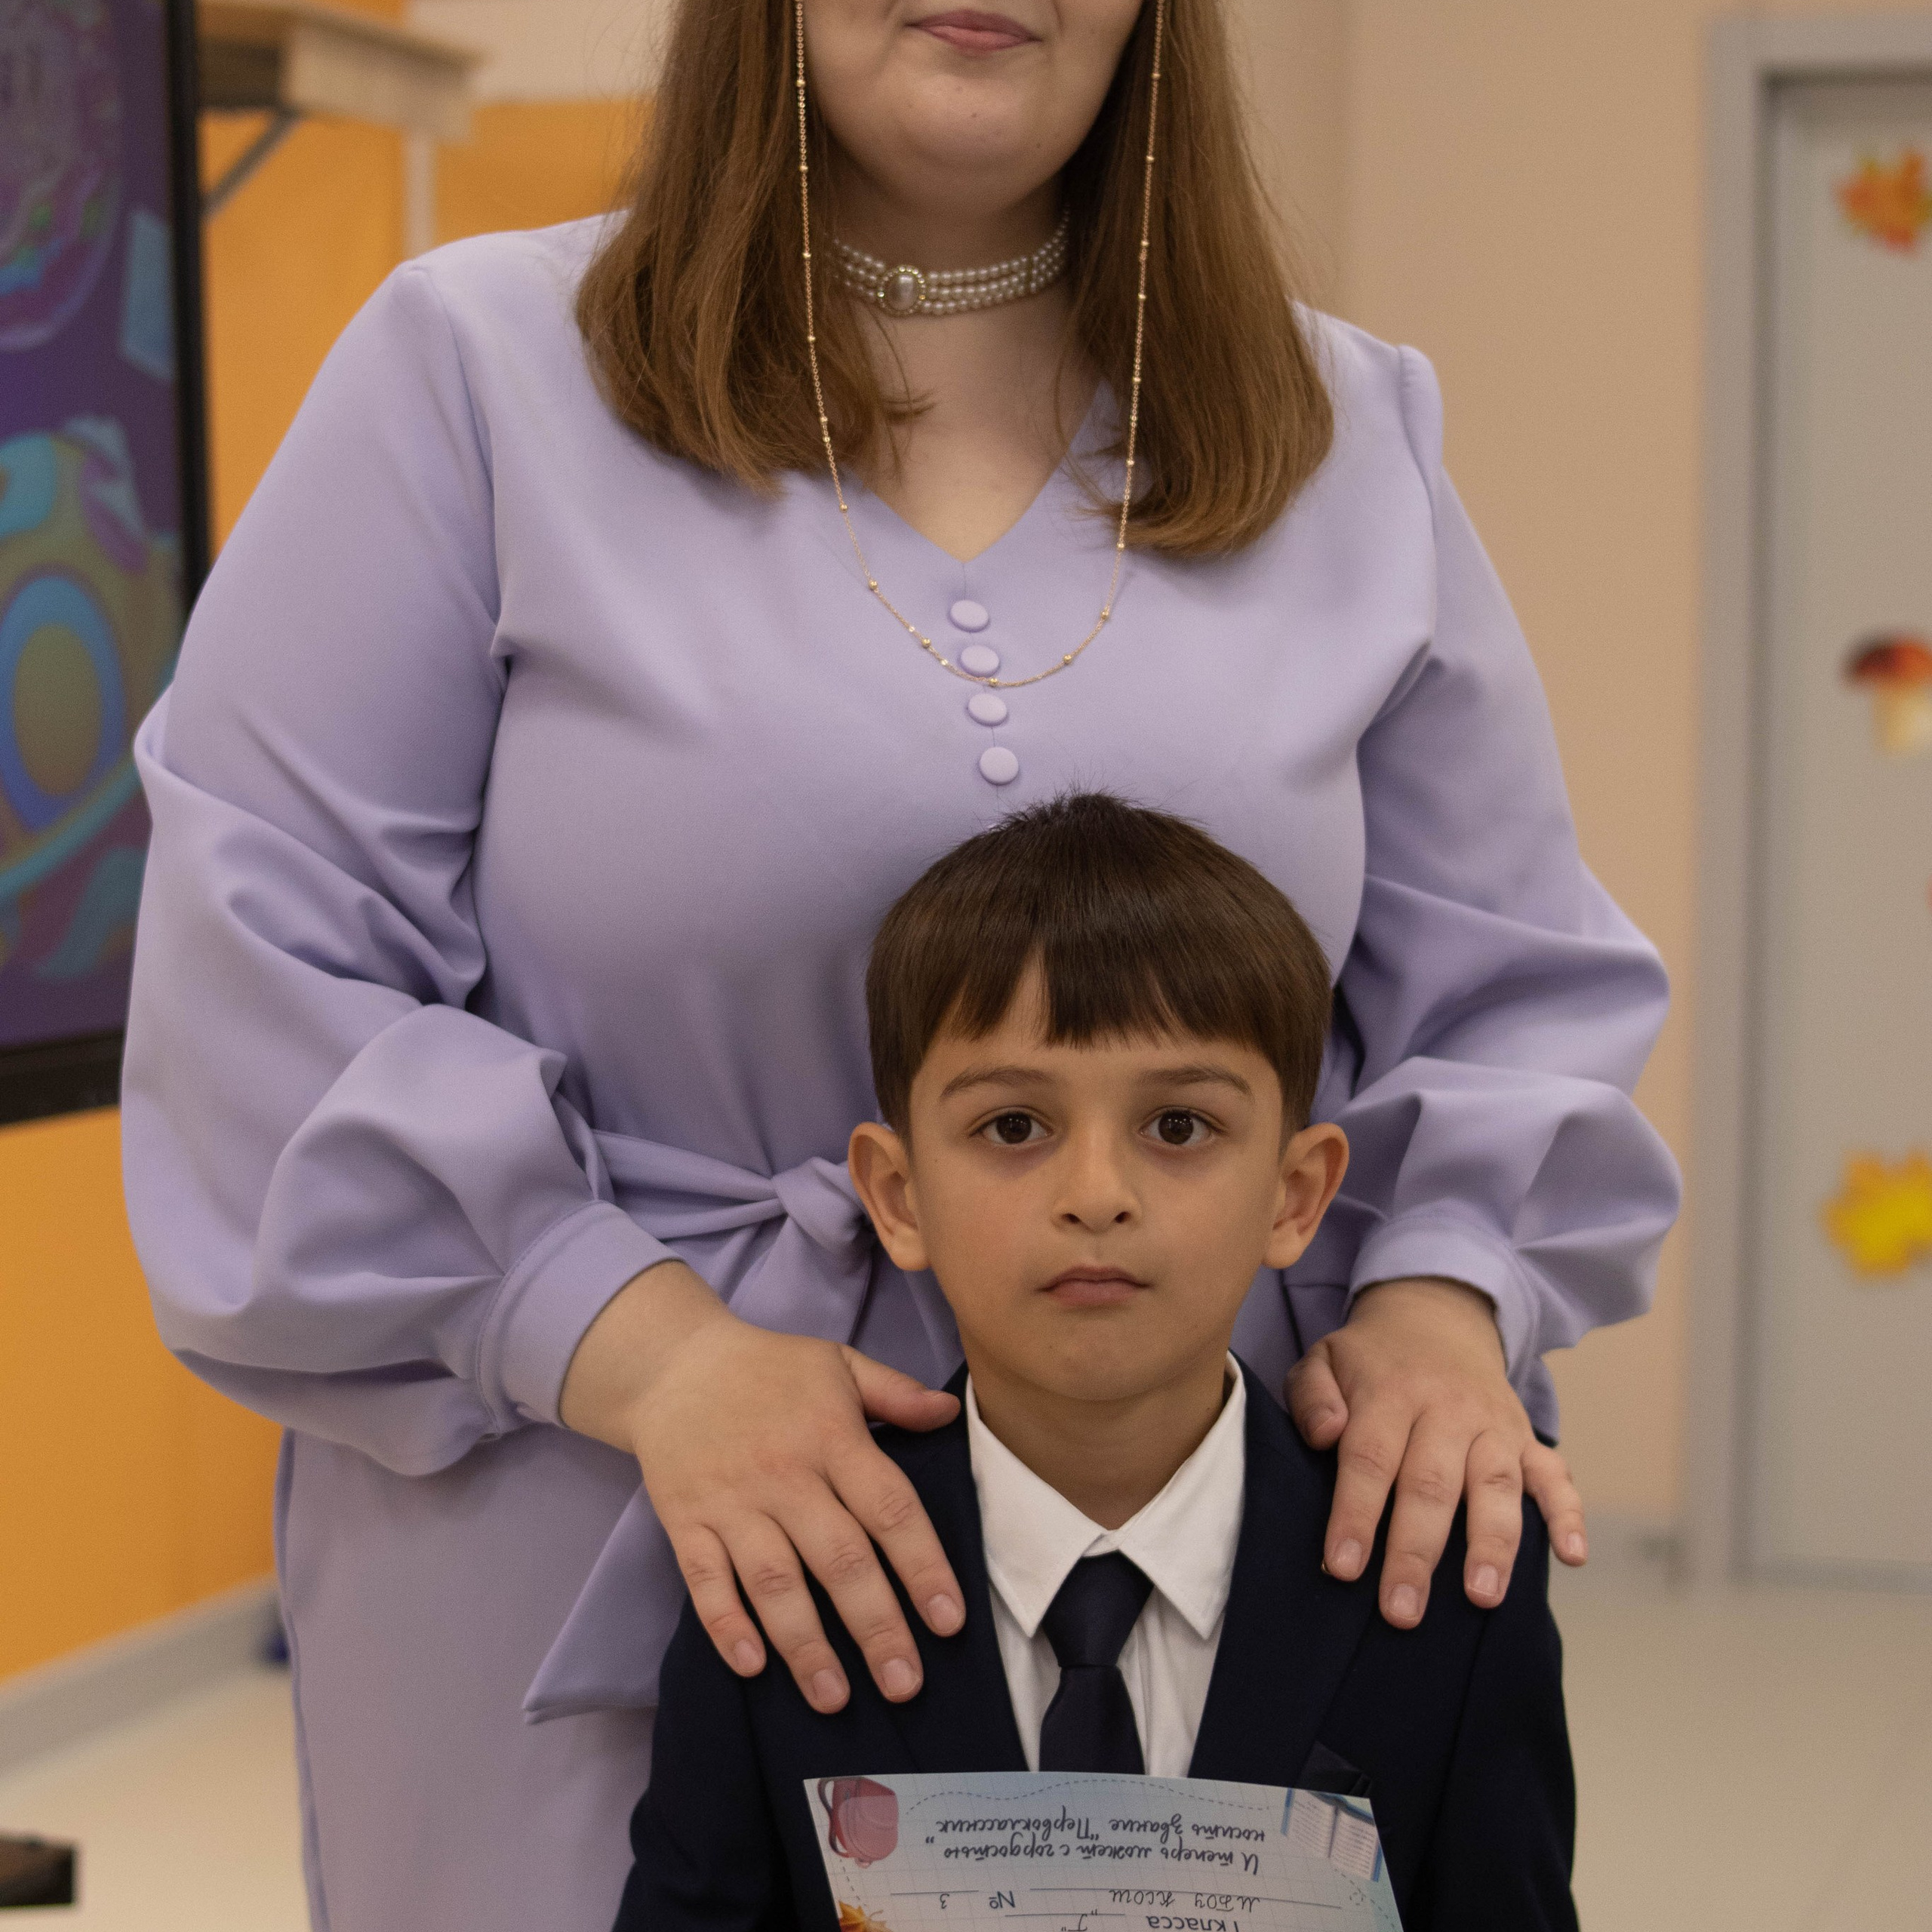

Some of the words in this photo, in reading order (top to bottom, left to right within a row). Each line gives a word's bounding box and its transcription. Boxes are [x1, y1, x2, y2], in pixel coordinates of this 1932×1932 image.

[1109, 1813, 1183, 1844] звание
[1192, 1823, 1265, 1841] носить
[943, 1832, 1055, 1861] гордостью
[1059, 1844, 1070, 1856] с
[1076, 1844, 1152, 1860] может
[1160, 1835, 1233, 1866] теперь
[1242, 1852, 1259, 1875] И
[940, 1894, 950, 1909] 3
[989, 1890, 1016, 1909] №
[1146, 1916, 1226, 1932] класса
